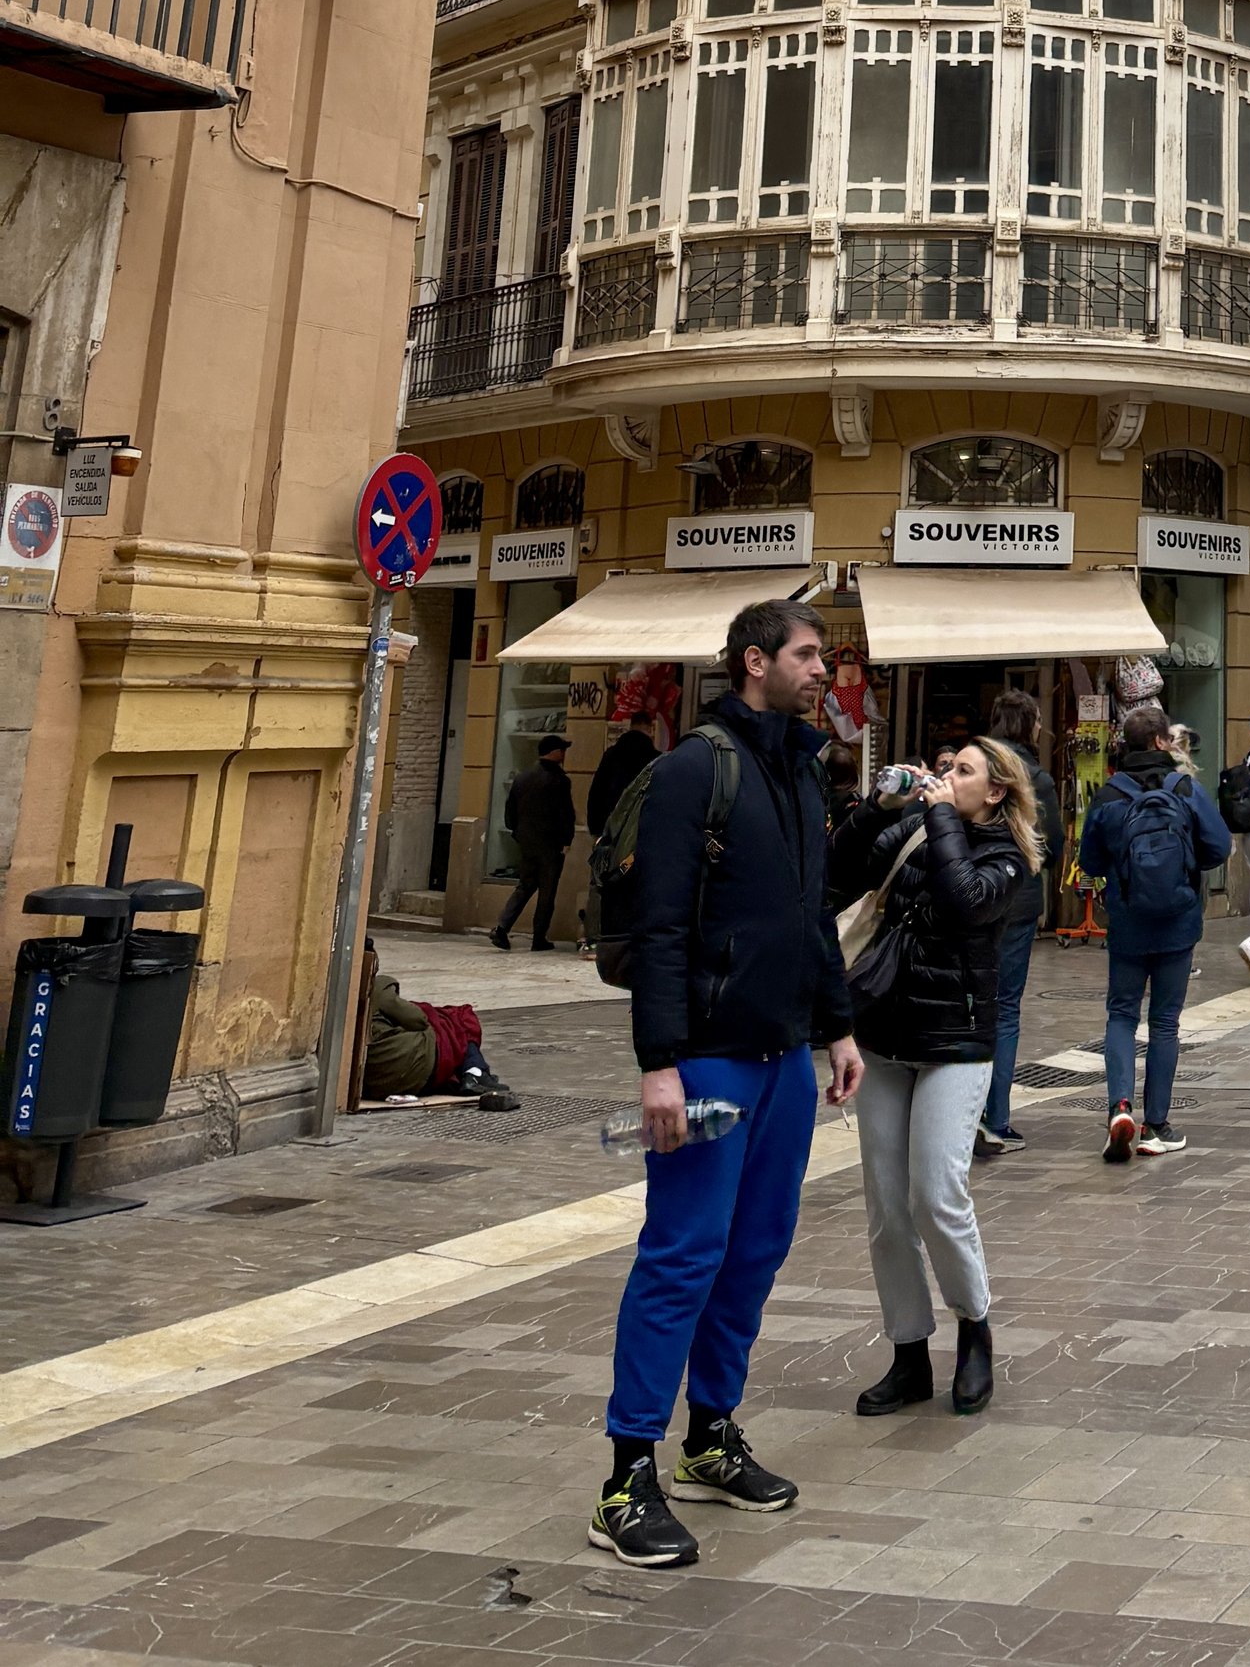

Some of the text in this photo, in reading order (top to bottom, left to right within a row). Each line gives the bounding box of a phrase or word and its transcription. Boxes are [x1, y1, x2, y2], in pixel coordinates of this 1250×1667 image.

[43, 398, 61, 431] 8
[83, 454, 96, 464] LUZ
[69, 468, 106, 479] ENCENDIDA
[75, 482, 98, 492] SALIDA
[677, 524, 796, 547] SOUVENIRS
[909, 523, 1060, 543] SOUVENIRS
[1157, 529, 1241, 554] SOUVENIRS
[498, 541, 565, 563] SOUVENIRS
[733, 544, 795, 553] VICTORIA
[983, 543, 1059, 552] VICTORIA
[1199, 553, 1241, 561] VICTORIA
[528, 559, 564, 568] VICTORIA
[19, 982, 50, 1119] GRACIAS
